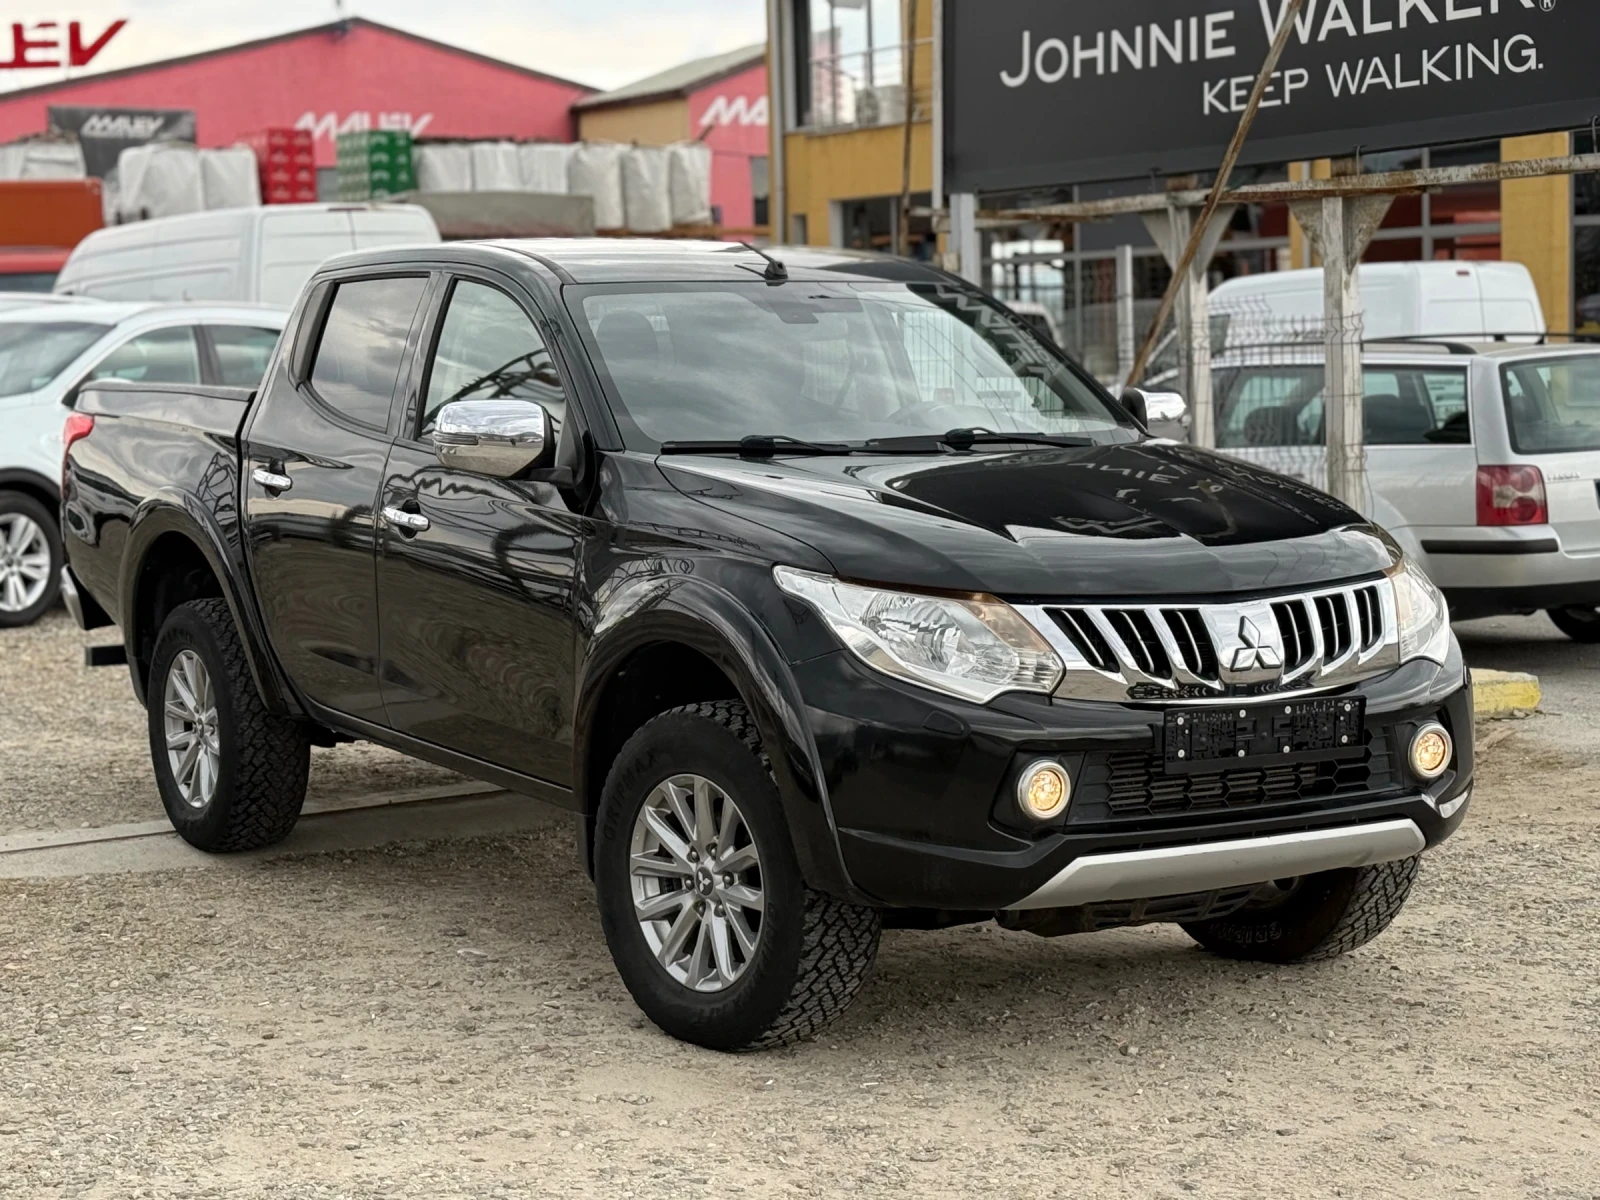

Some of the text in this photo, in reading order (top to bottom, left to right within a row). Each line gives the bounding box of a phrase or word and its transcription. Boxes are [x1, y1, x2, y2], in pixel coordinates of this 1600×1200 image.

[999, 10, 1236, 88] JOHNNIE
[1203, 34, 1544, 116] KEEP WALKING.
